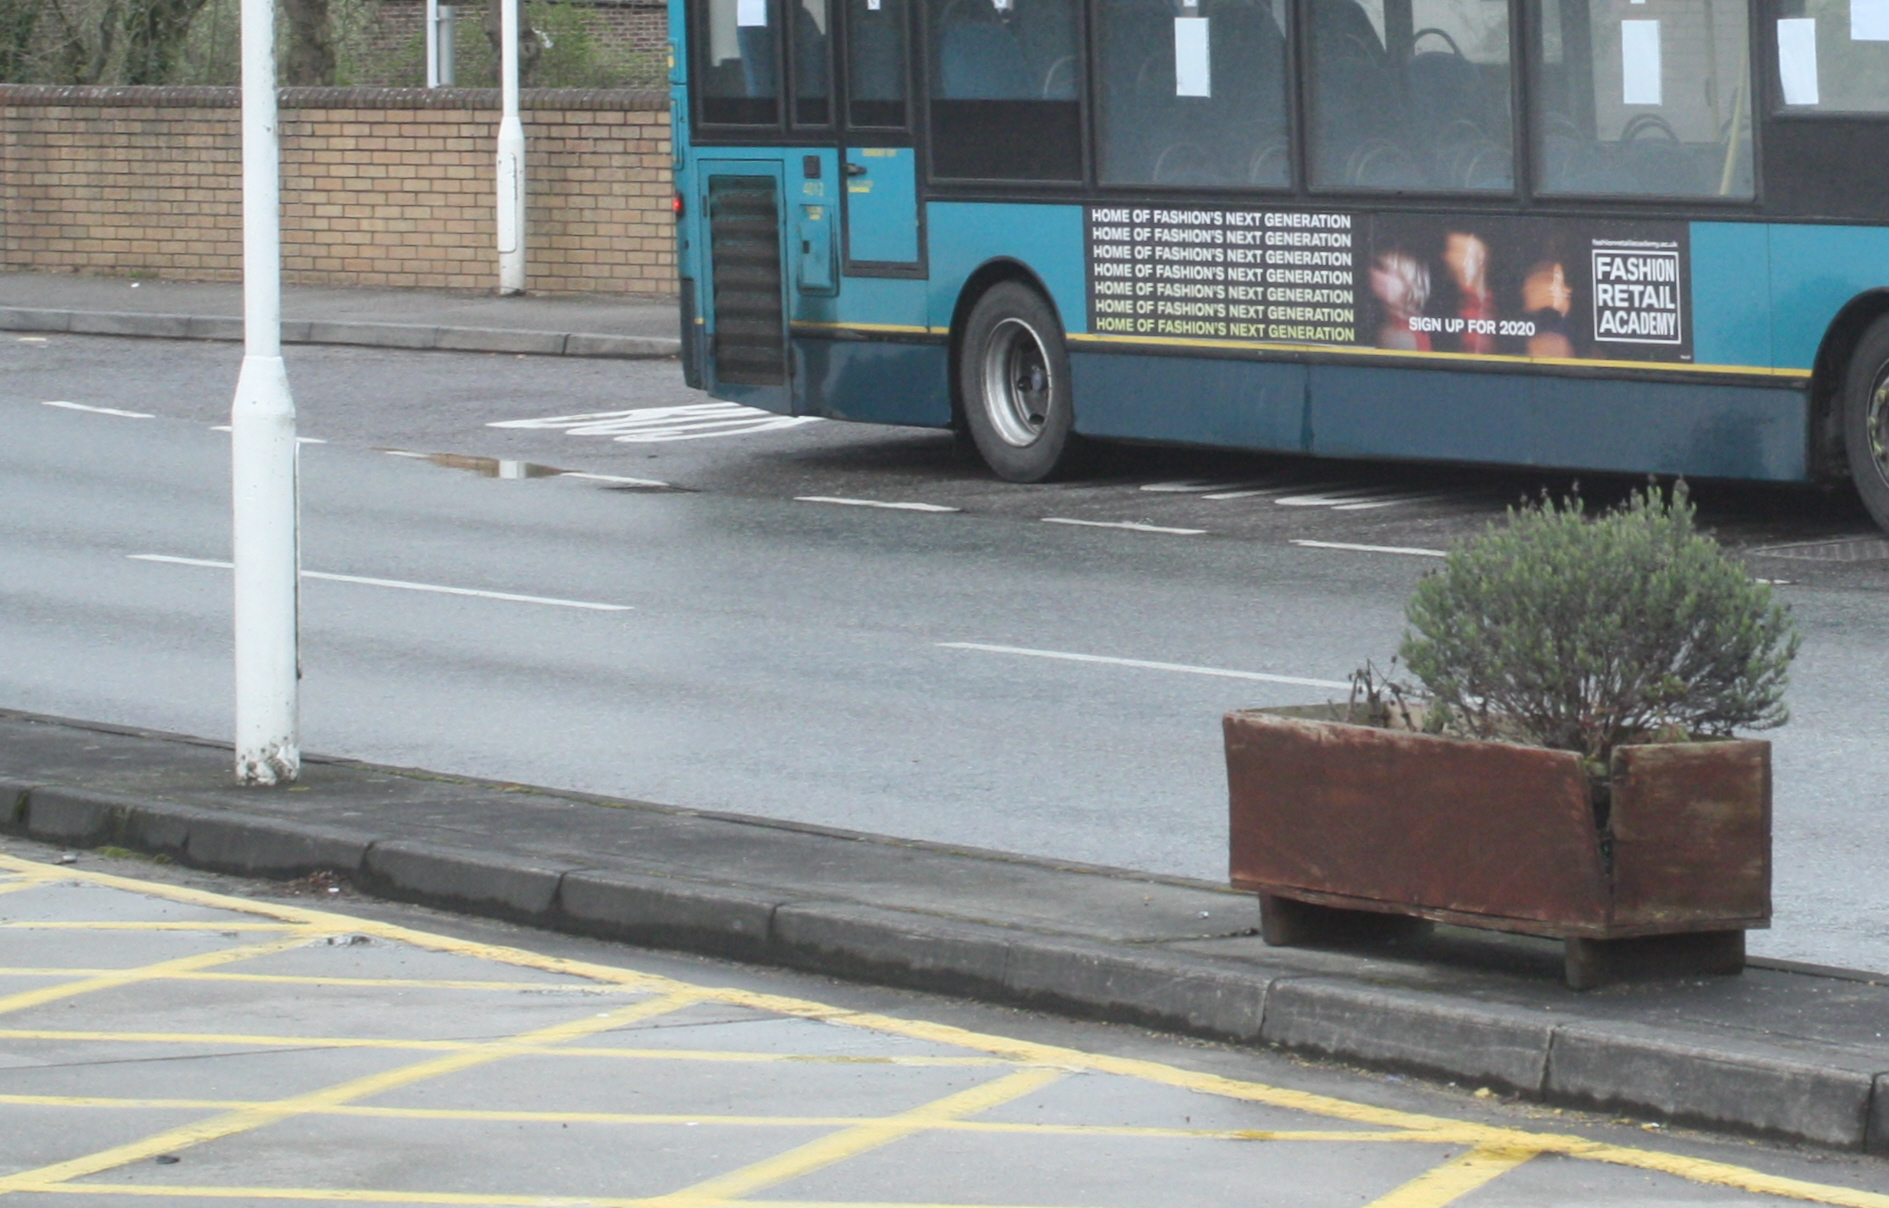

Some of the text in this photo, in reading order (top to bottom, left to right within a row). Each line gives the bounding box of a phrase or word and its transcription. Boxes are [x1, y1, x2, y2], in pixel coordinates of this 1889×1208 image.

[1092, 208, 1130, 222] HOME
[1132, 209, 1150, 224] OF
[1226, 212, 1262, 227] NEXT
[1264, 213, 1351, 229] GENERATION
[1093, 227, 1131, 241] HOME
[1133, 227, 1151, 242] OF
[1226, 230, 1262, 246] NEXT
[1265, 232, 1352, 248] GENERATION
[1093, 245, 1131, 259] HOME
[1134, 245, 1152, 260] OF
[1227, 249, 1263, 264] NEXT
[1266, 250, 1352, 266] GENERATION
[1094, 263, 1132, 277] HOME
[1135, 263, 1153, 278] OF
[1228, 268, 1264, 282] NEXT
[1267, 269, 1353, 285] GENERATION
[1596, 256, 1675, 282] FASHION
[1095, 281, 1133, 295] HOME
[1135, 281, 1153, 296] OF
[1228, 286, 1264, 301] NEXT
[1267, 287, 1354, 303] GENERATION
[1597, 283, 1676, 309] RETAIL
[1096, 299, 1134, 313] HOME
[1136, 300, 1154, 314] OF
[1229, 304, 1265, 320] NEXT
[1268, 306, 1354, 322] GENERATION
[1096, 317, 1134, 331] HOME
[1137, 318, 1155, 332] OF
[1230, 323, 1266, 338] NEXT
[1269, 325, 1355, 341] GENERATION
[1409, 316, 1535, 337] SIGN UP FOR 2020
[1599, 310, 1676, 336] ACADEMY
